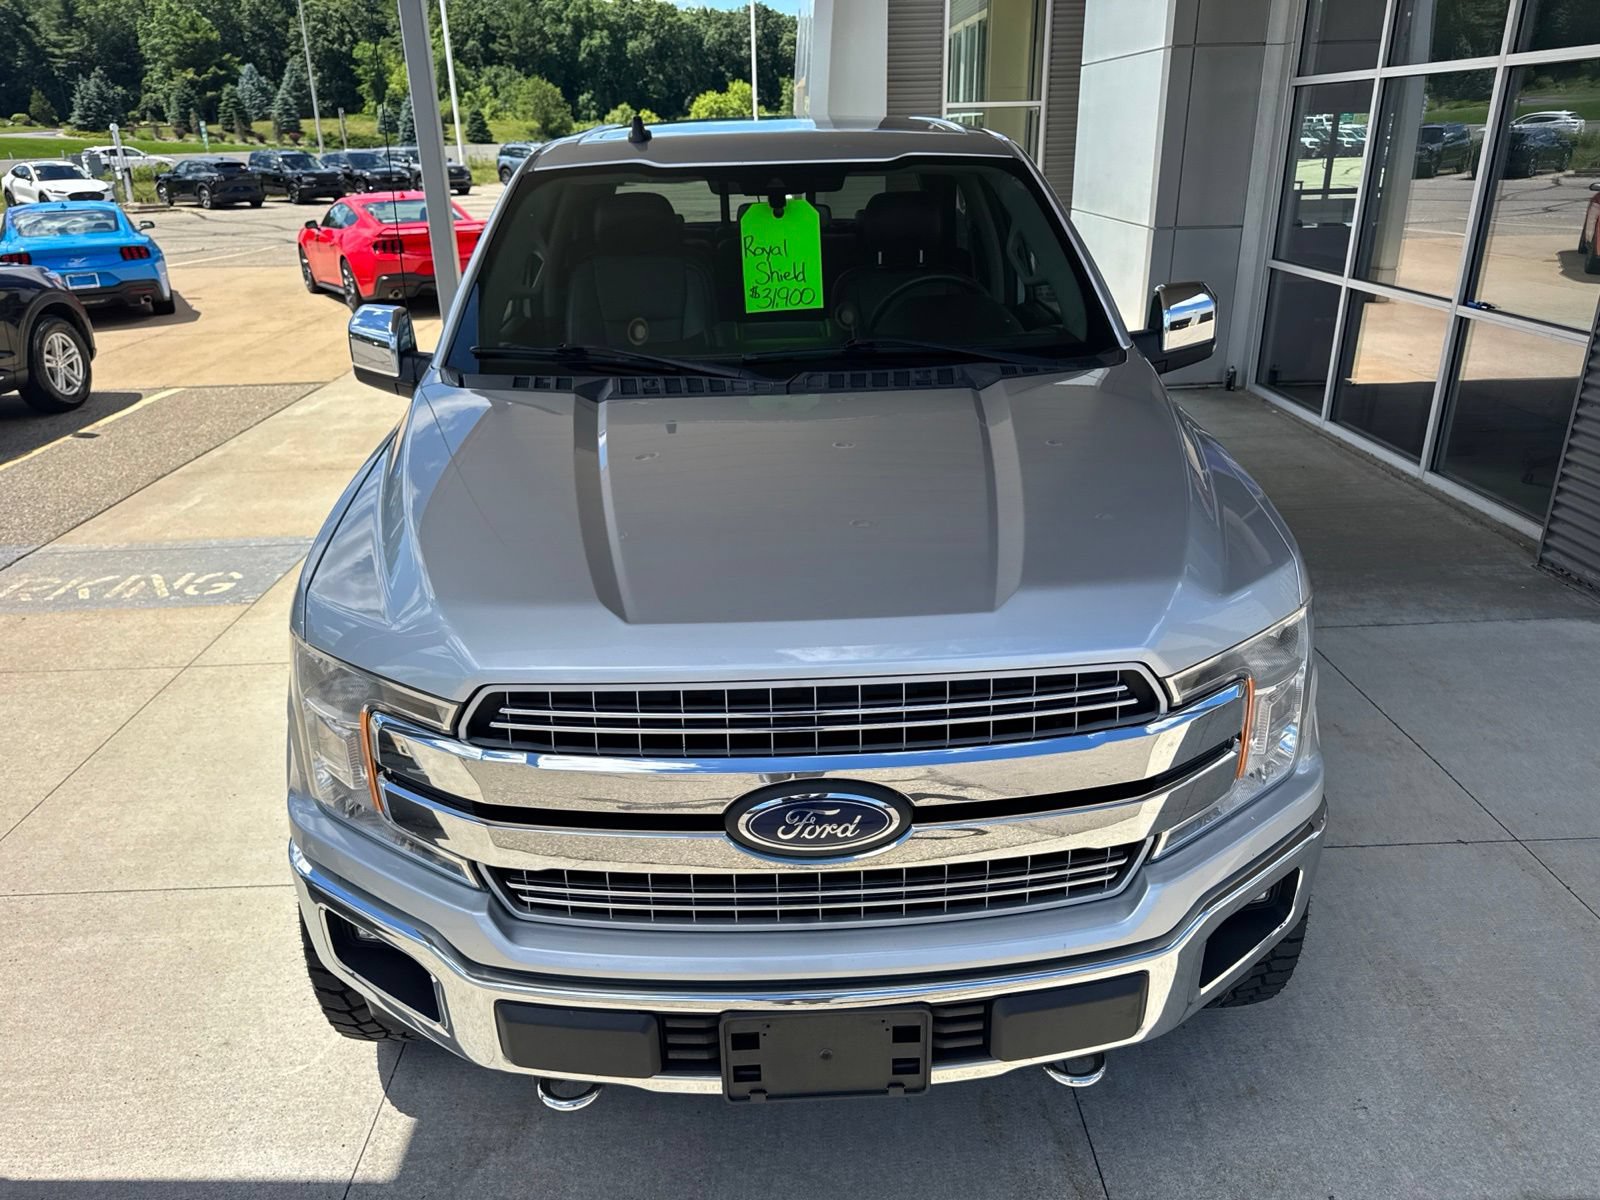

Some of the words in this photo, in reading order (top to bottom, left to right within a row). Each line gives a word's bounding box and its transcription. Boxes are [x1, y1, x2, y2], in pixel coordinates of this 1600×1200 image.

[743, 235, 788, 263] Royal
[755, 261, 807, 286] Shield
[750, 285, 816, 309] $31,900
[777, 808, 862, 840] Ford
